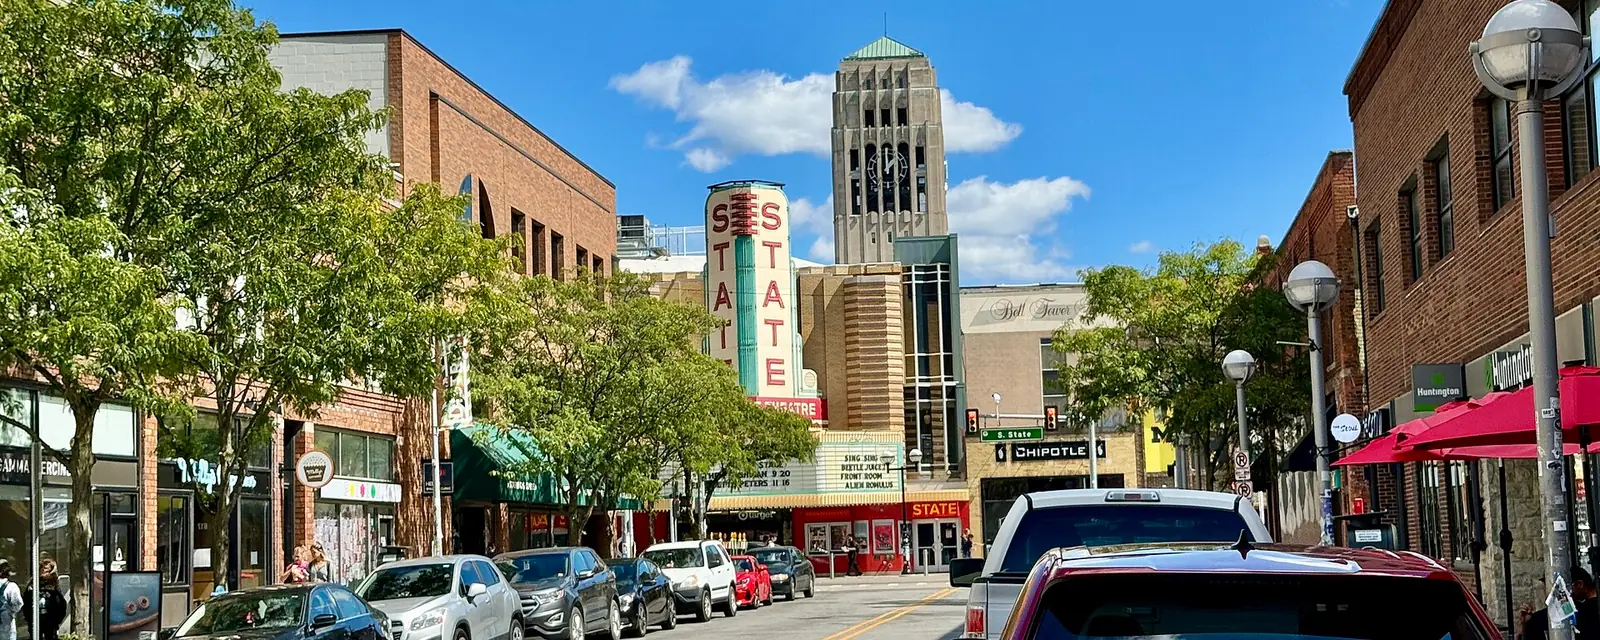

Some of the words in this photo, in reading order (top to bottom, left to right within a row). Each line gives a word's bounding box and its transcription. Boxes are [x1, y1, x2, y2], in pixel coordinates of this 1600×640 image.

[761, 202, 786, 386] STATE
[990, 298, 1026, 320] Bell
[1029, 298, 1071, 319] Tower
[1417, 387, 1460, 397] Huntington
[1008, 430, 1032, 438] State
[1016, 446, 1086, 458] CHIPOTLE
[864, 454, 878, 462] SING
[864, 472, 883, 480] ROOM
[866, 481, 894, 489] ROMULUS
[912, 502, 957, 516] STATE
[749, 511, 774, 521] target
